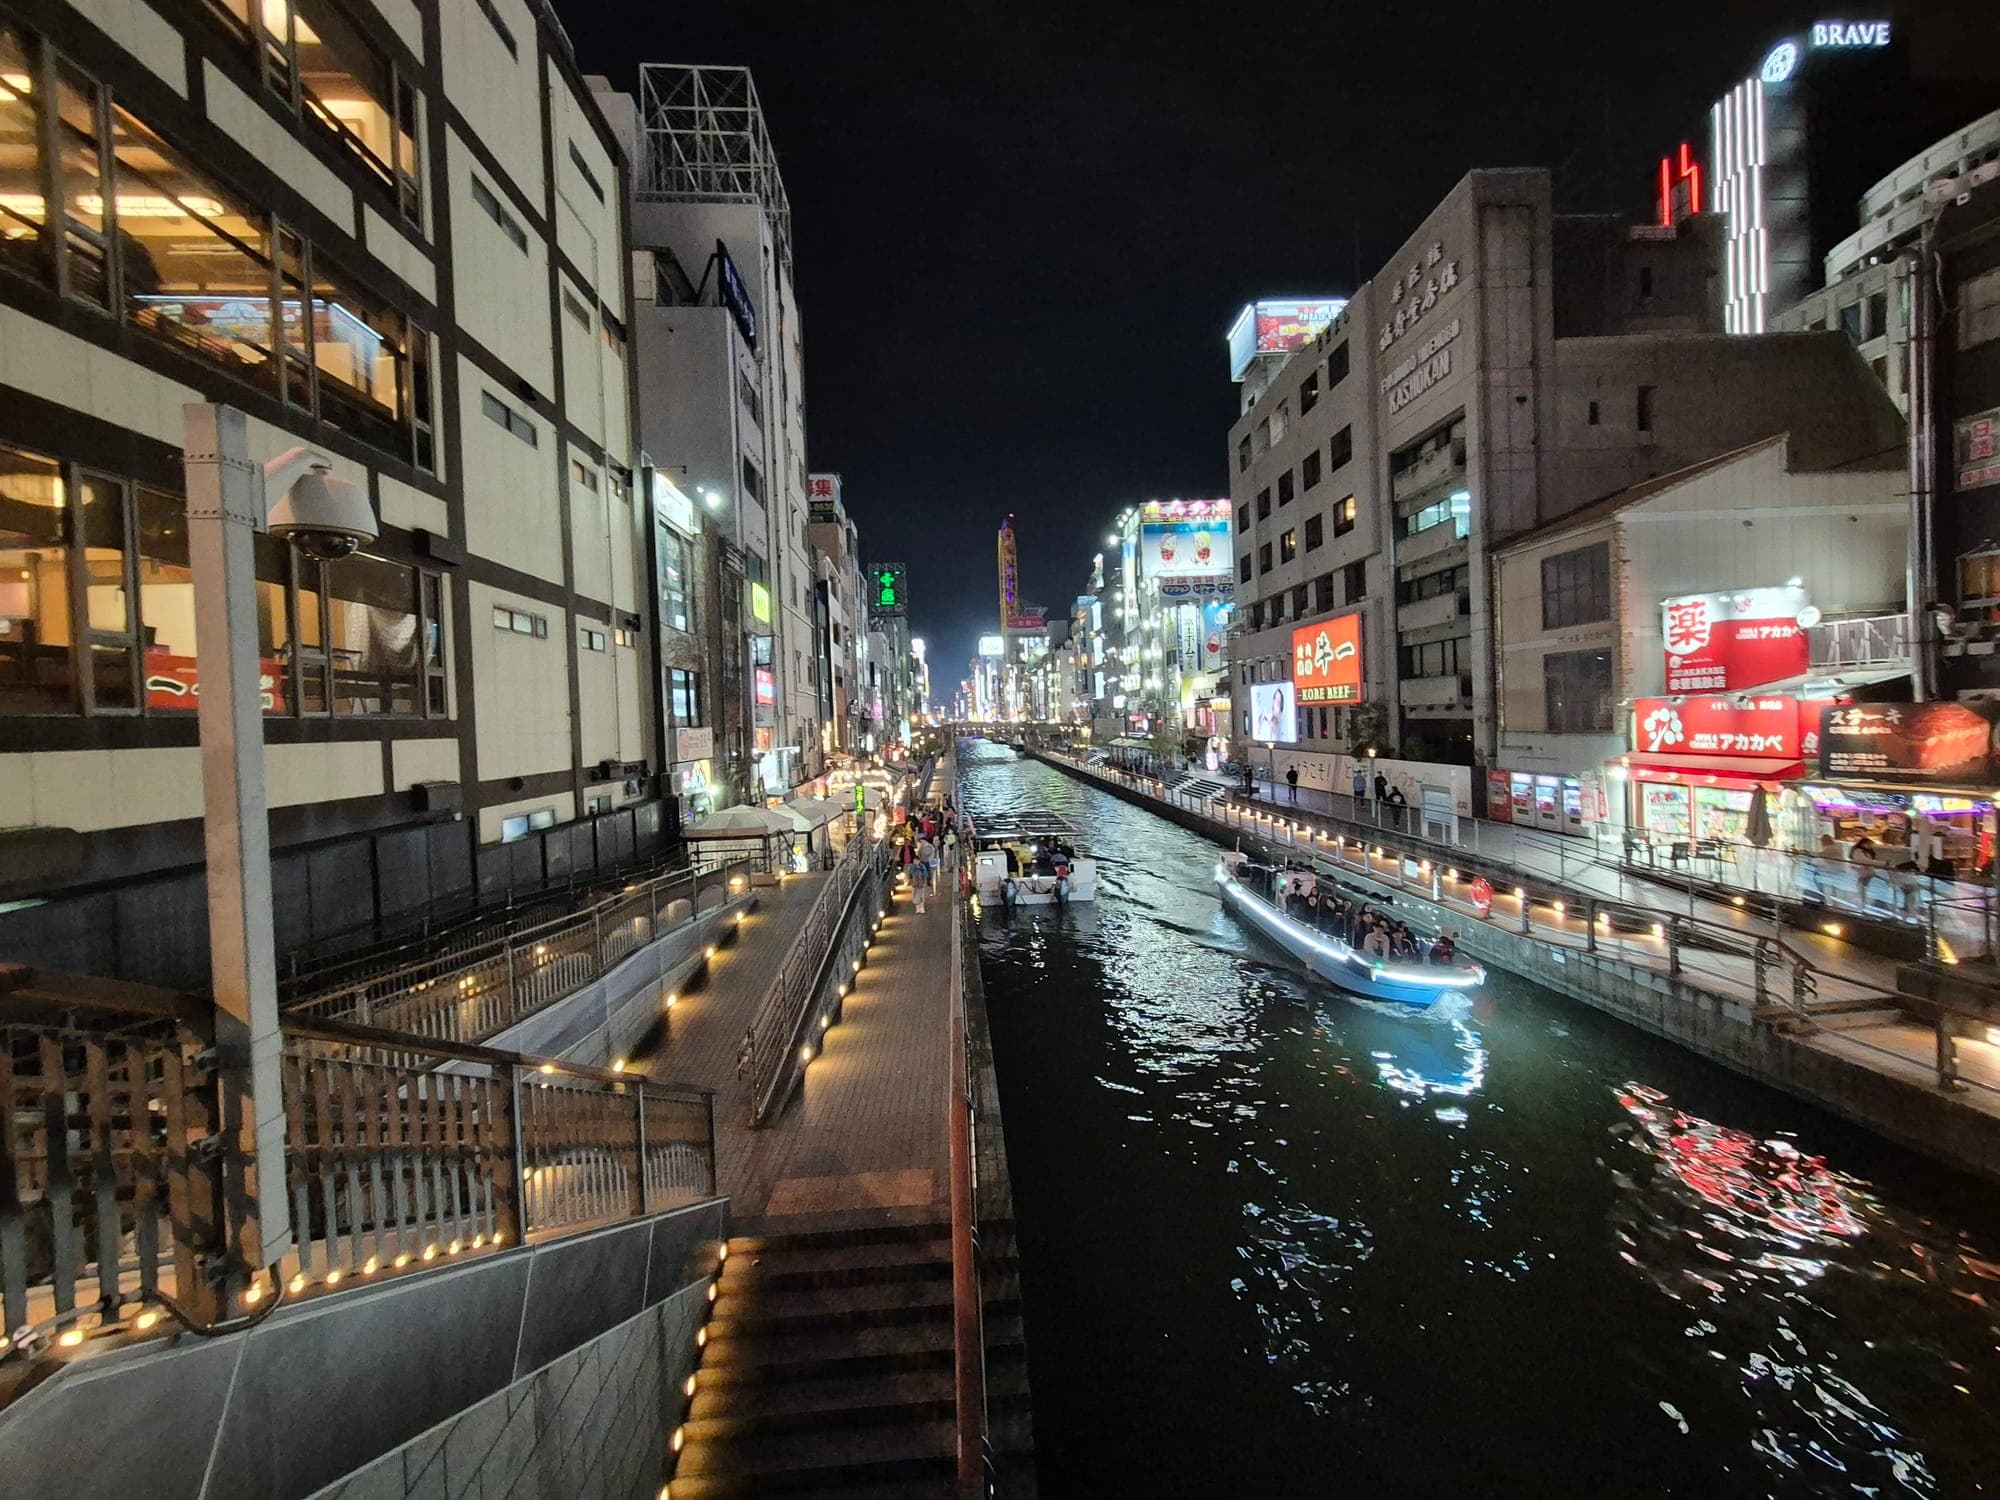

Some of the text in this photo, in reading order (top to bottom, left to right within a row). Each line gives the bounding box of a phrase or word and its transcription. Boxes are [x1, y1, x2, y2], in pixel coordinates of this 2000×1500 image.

[1813, 22, 1890, 46] BRAVE
[1668, 601, 1706, 647] 薬
[1302, 685, 1350, 701] KOBE BEEF
[1829, 708, 1903, 726] ステーキ
[1720, 733, 1783, 751] アカカベ
